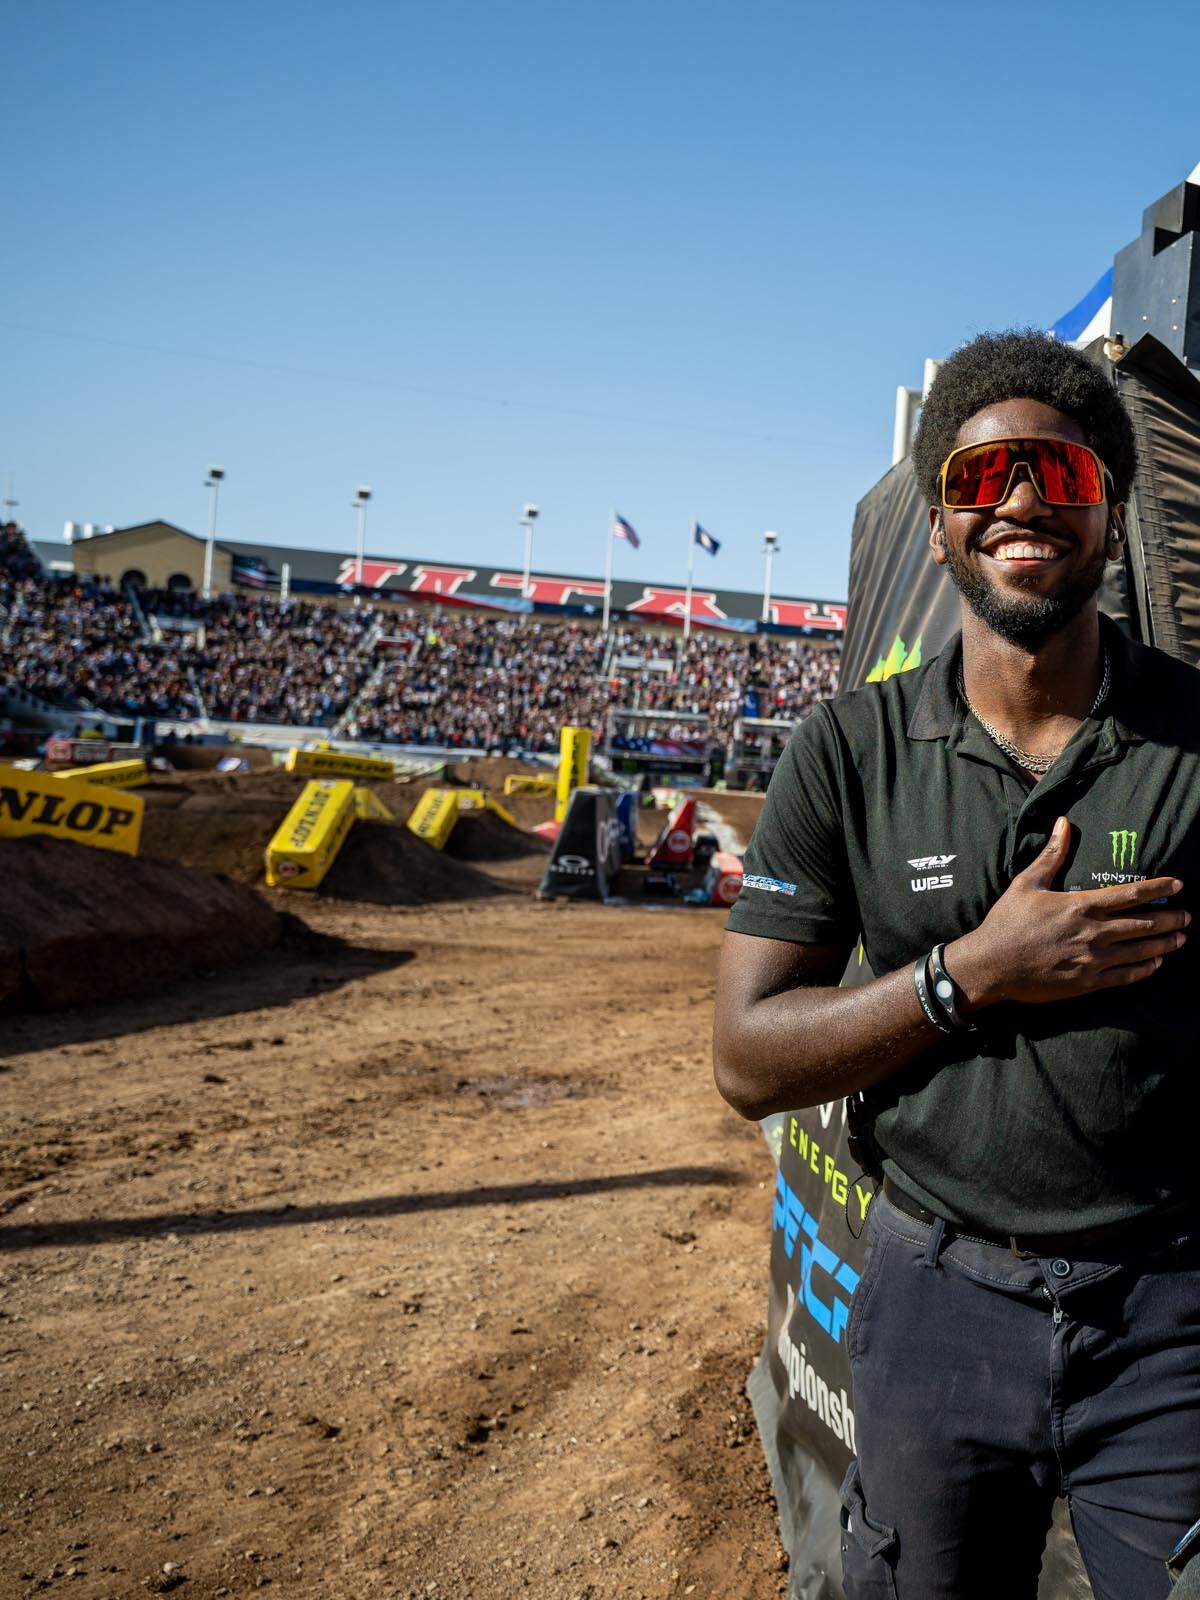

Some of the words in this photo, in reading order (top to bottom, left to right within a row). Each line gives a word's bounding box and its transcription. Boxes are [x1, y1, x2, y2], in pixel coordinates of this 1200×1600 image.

[0, 786, 134, 834] NLOP
[907, 854, 958, 868] FLY
[911, 874, 954, 892] WPS
[1091, 871, 1147, 883] MONSTER
[789, 1117, 873, 1221] ENERGY
